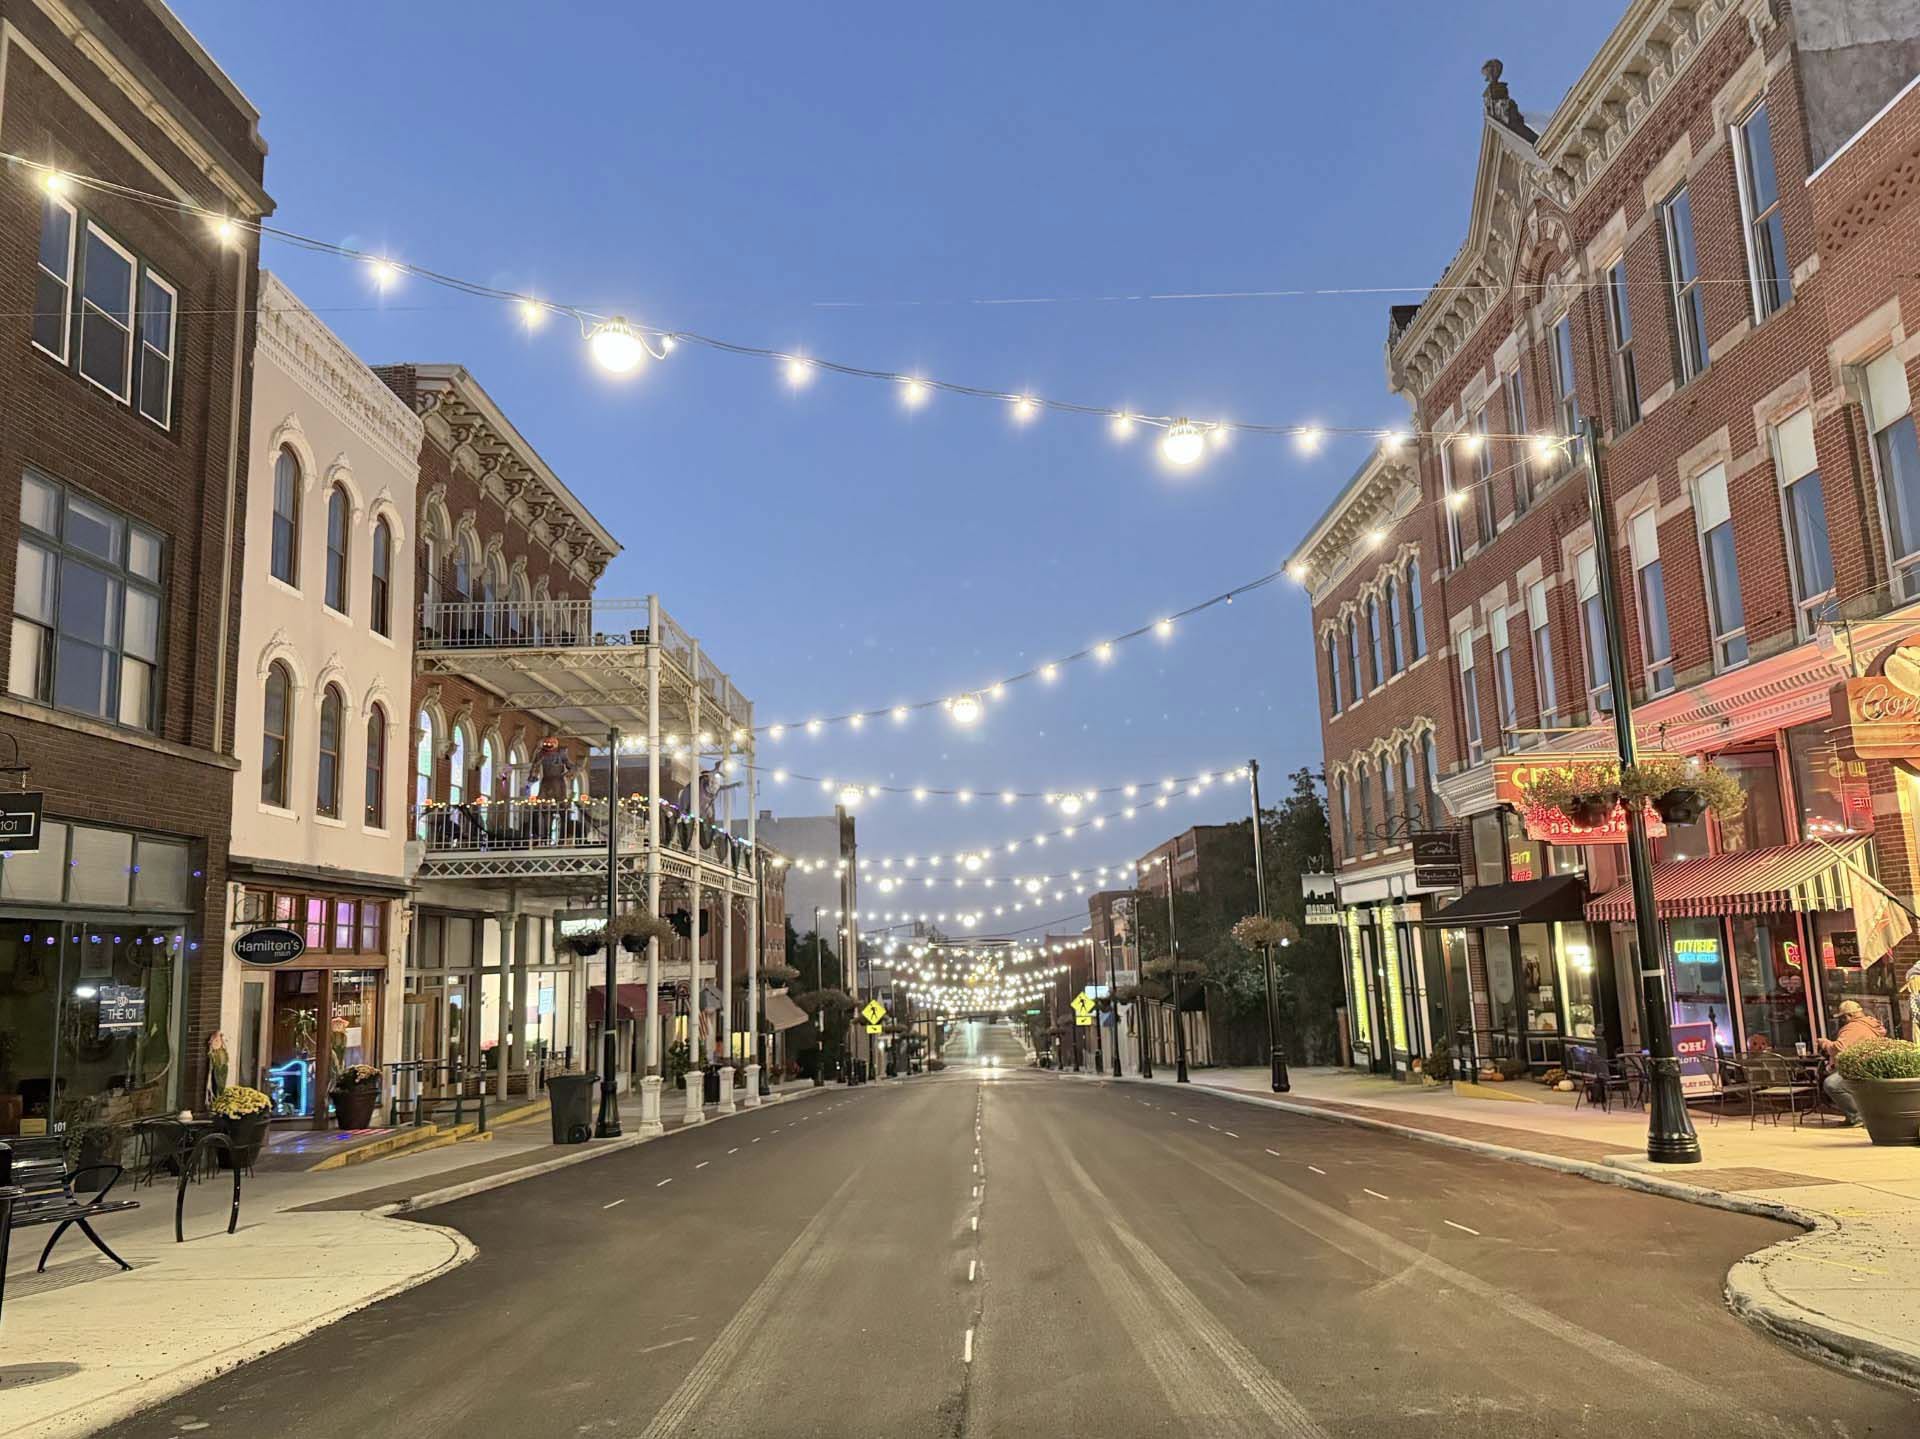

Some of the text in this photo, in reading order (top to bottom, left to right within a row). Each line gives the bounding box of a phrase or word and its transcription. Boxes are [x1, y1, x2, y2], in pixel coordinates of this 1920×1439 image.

[1, 820, 18, 831] 101
[237, 940, 300, 952] Hamilton's
[107, 1008, 136, 1019] THE 101
[1678, 1039, 1706, 1053] OH!
[54, 1121, 66, 1133] 101
